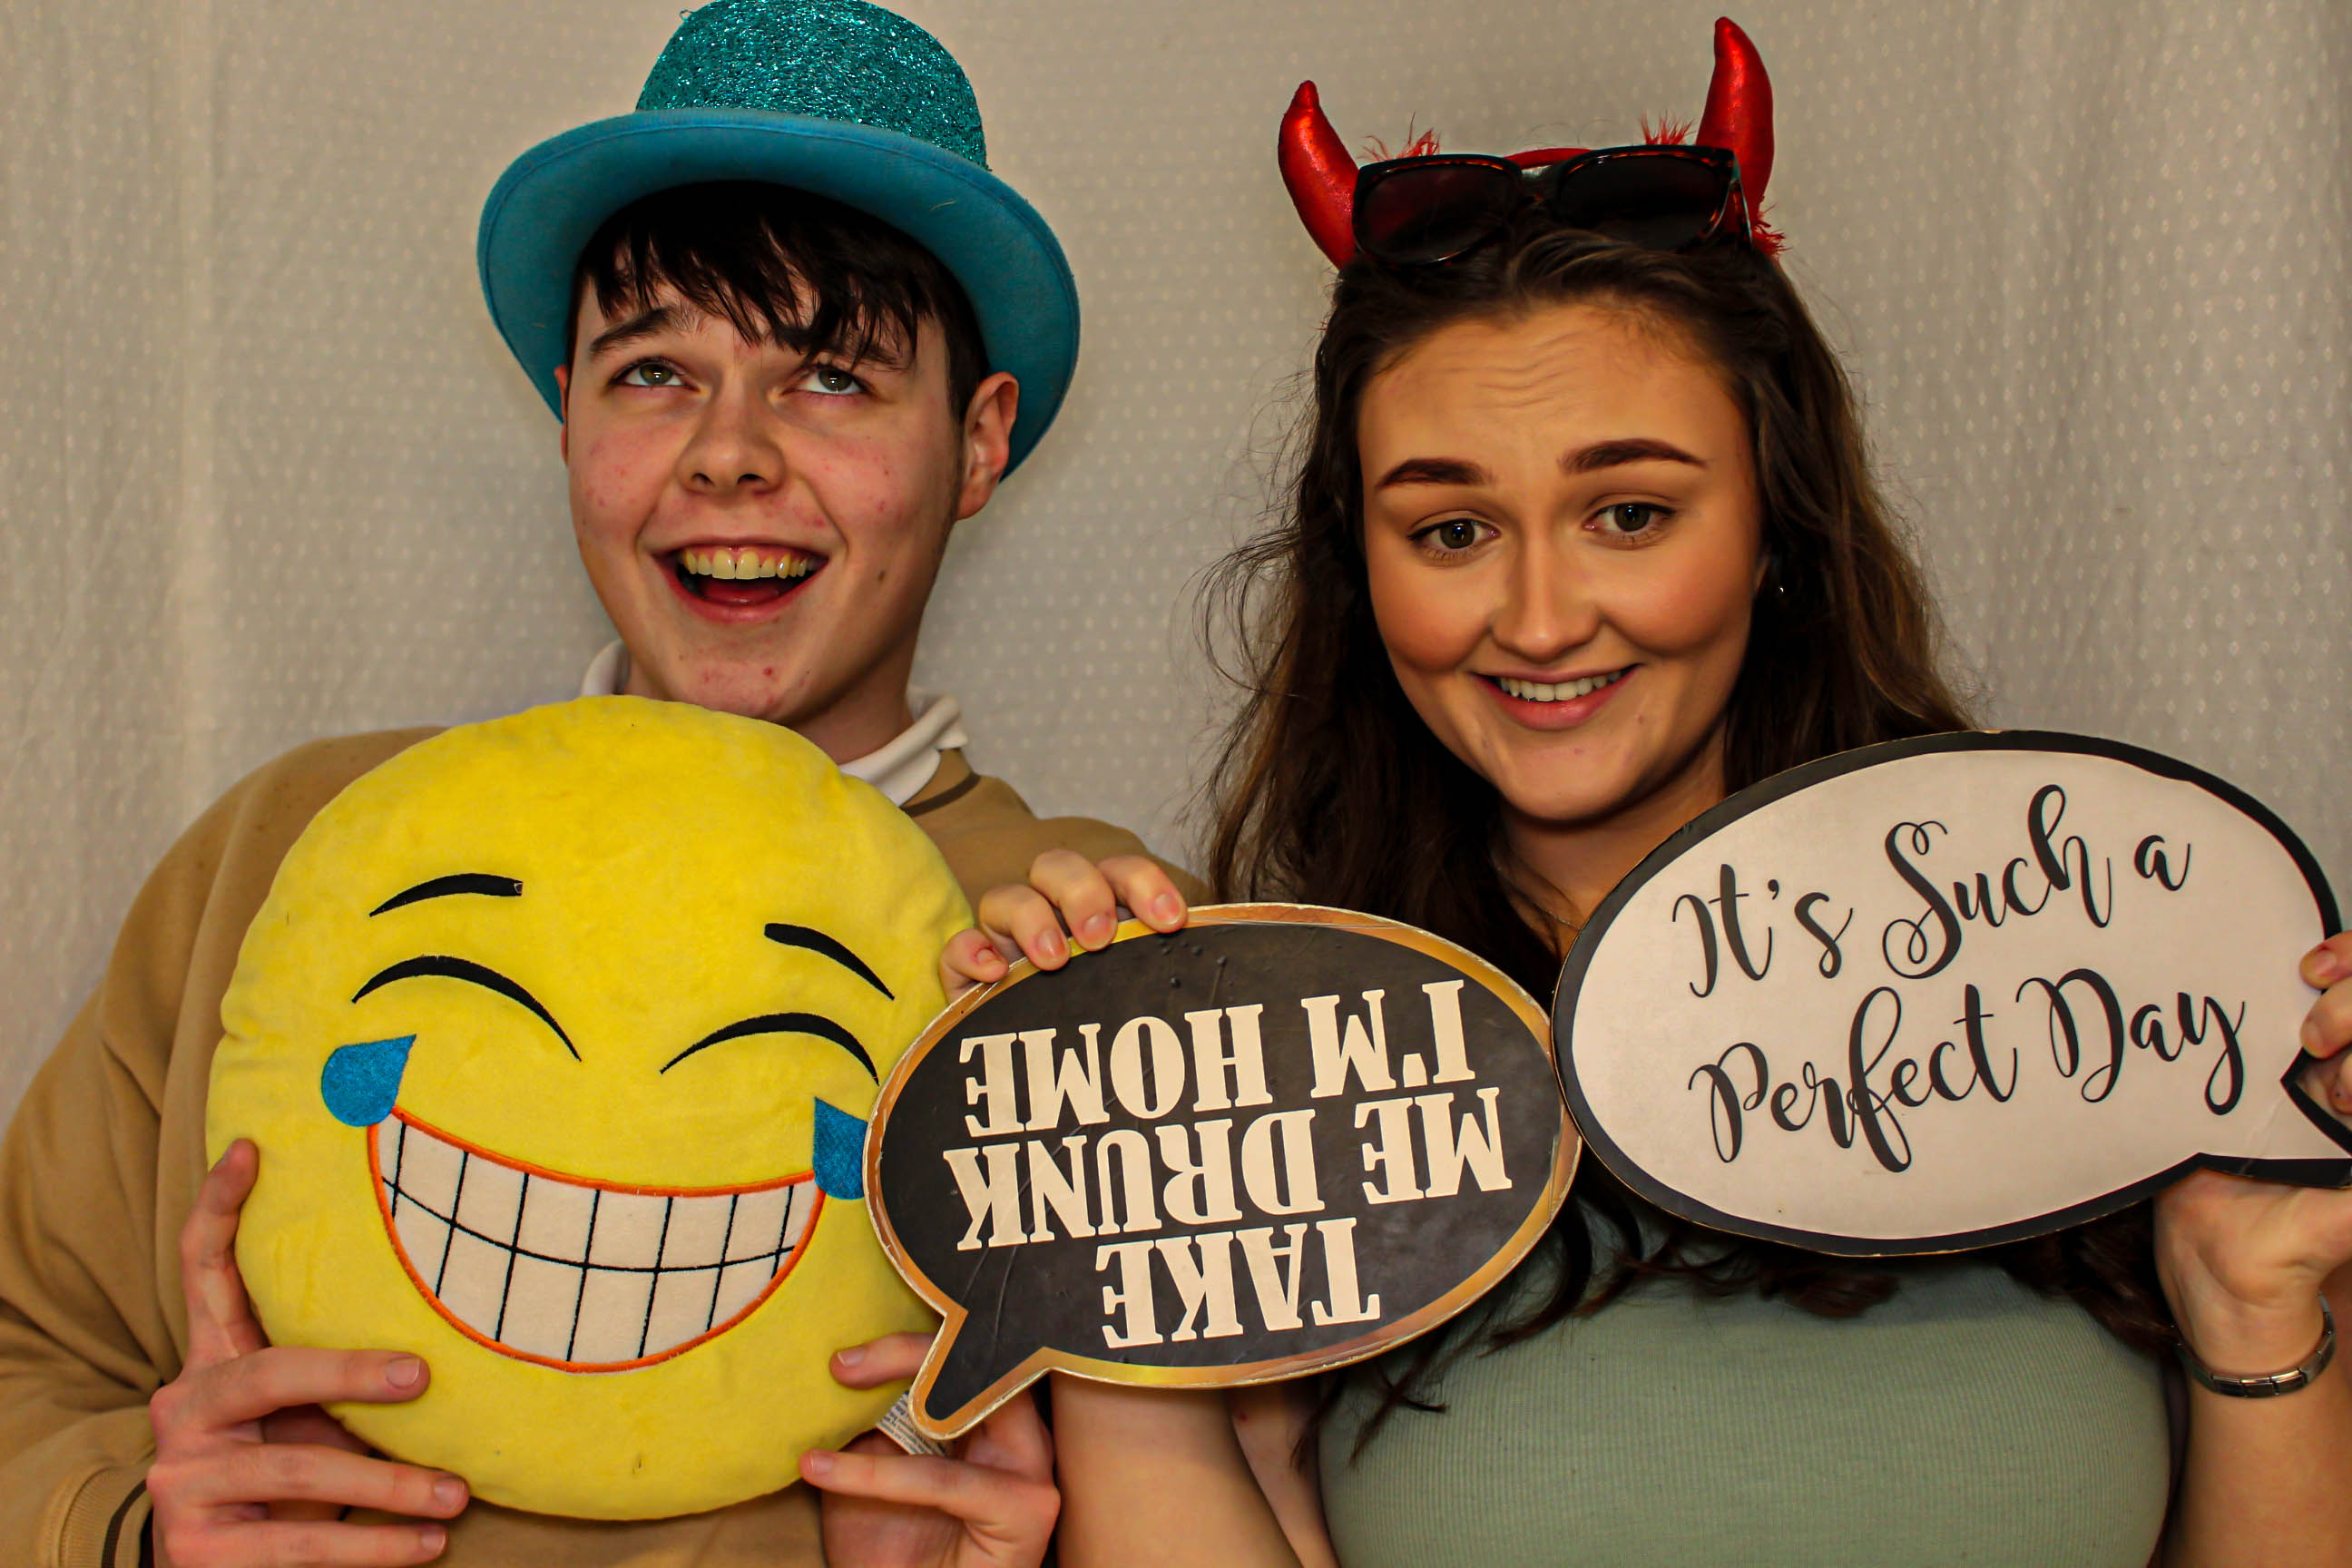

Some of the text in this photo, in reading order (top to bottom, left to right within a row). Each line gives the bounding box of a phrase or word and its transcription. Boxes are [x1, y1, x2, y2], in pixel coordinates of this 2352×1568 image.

[1671, 784, 2191, 998] It's Such a
[958, 979, 1476, 1138] I'M HOME
[1688, 968, 2246, 1173] Perfect Day
[943, 1086, 1513, 1251] ME DRUNK
[1095, 1217, 1381, 1349] TAKE
